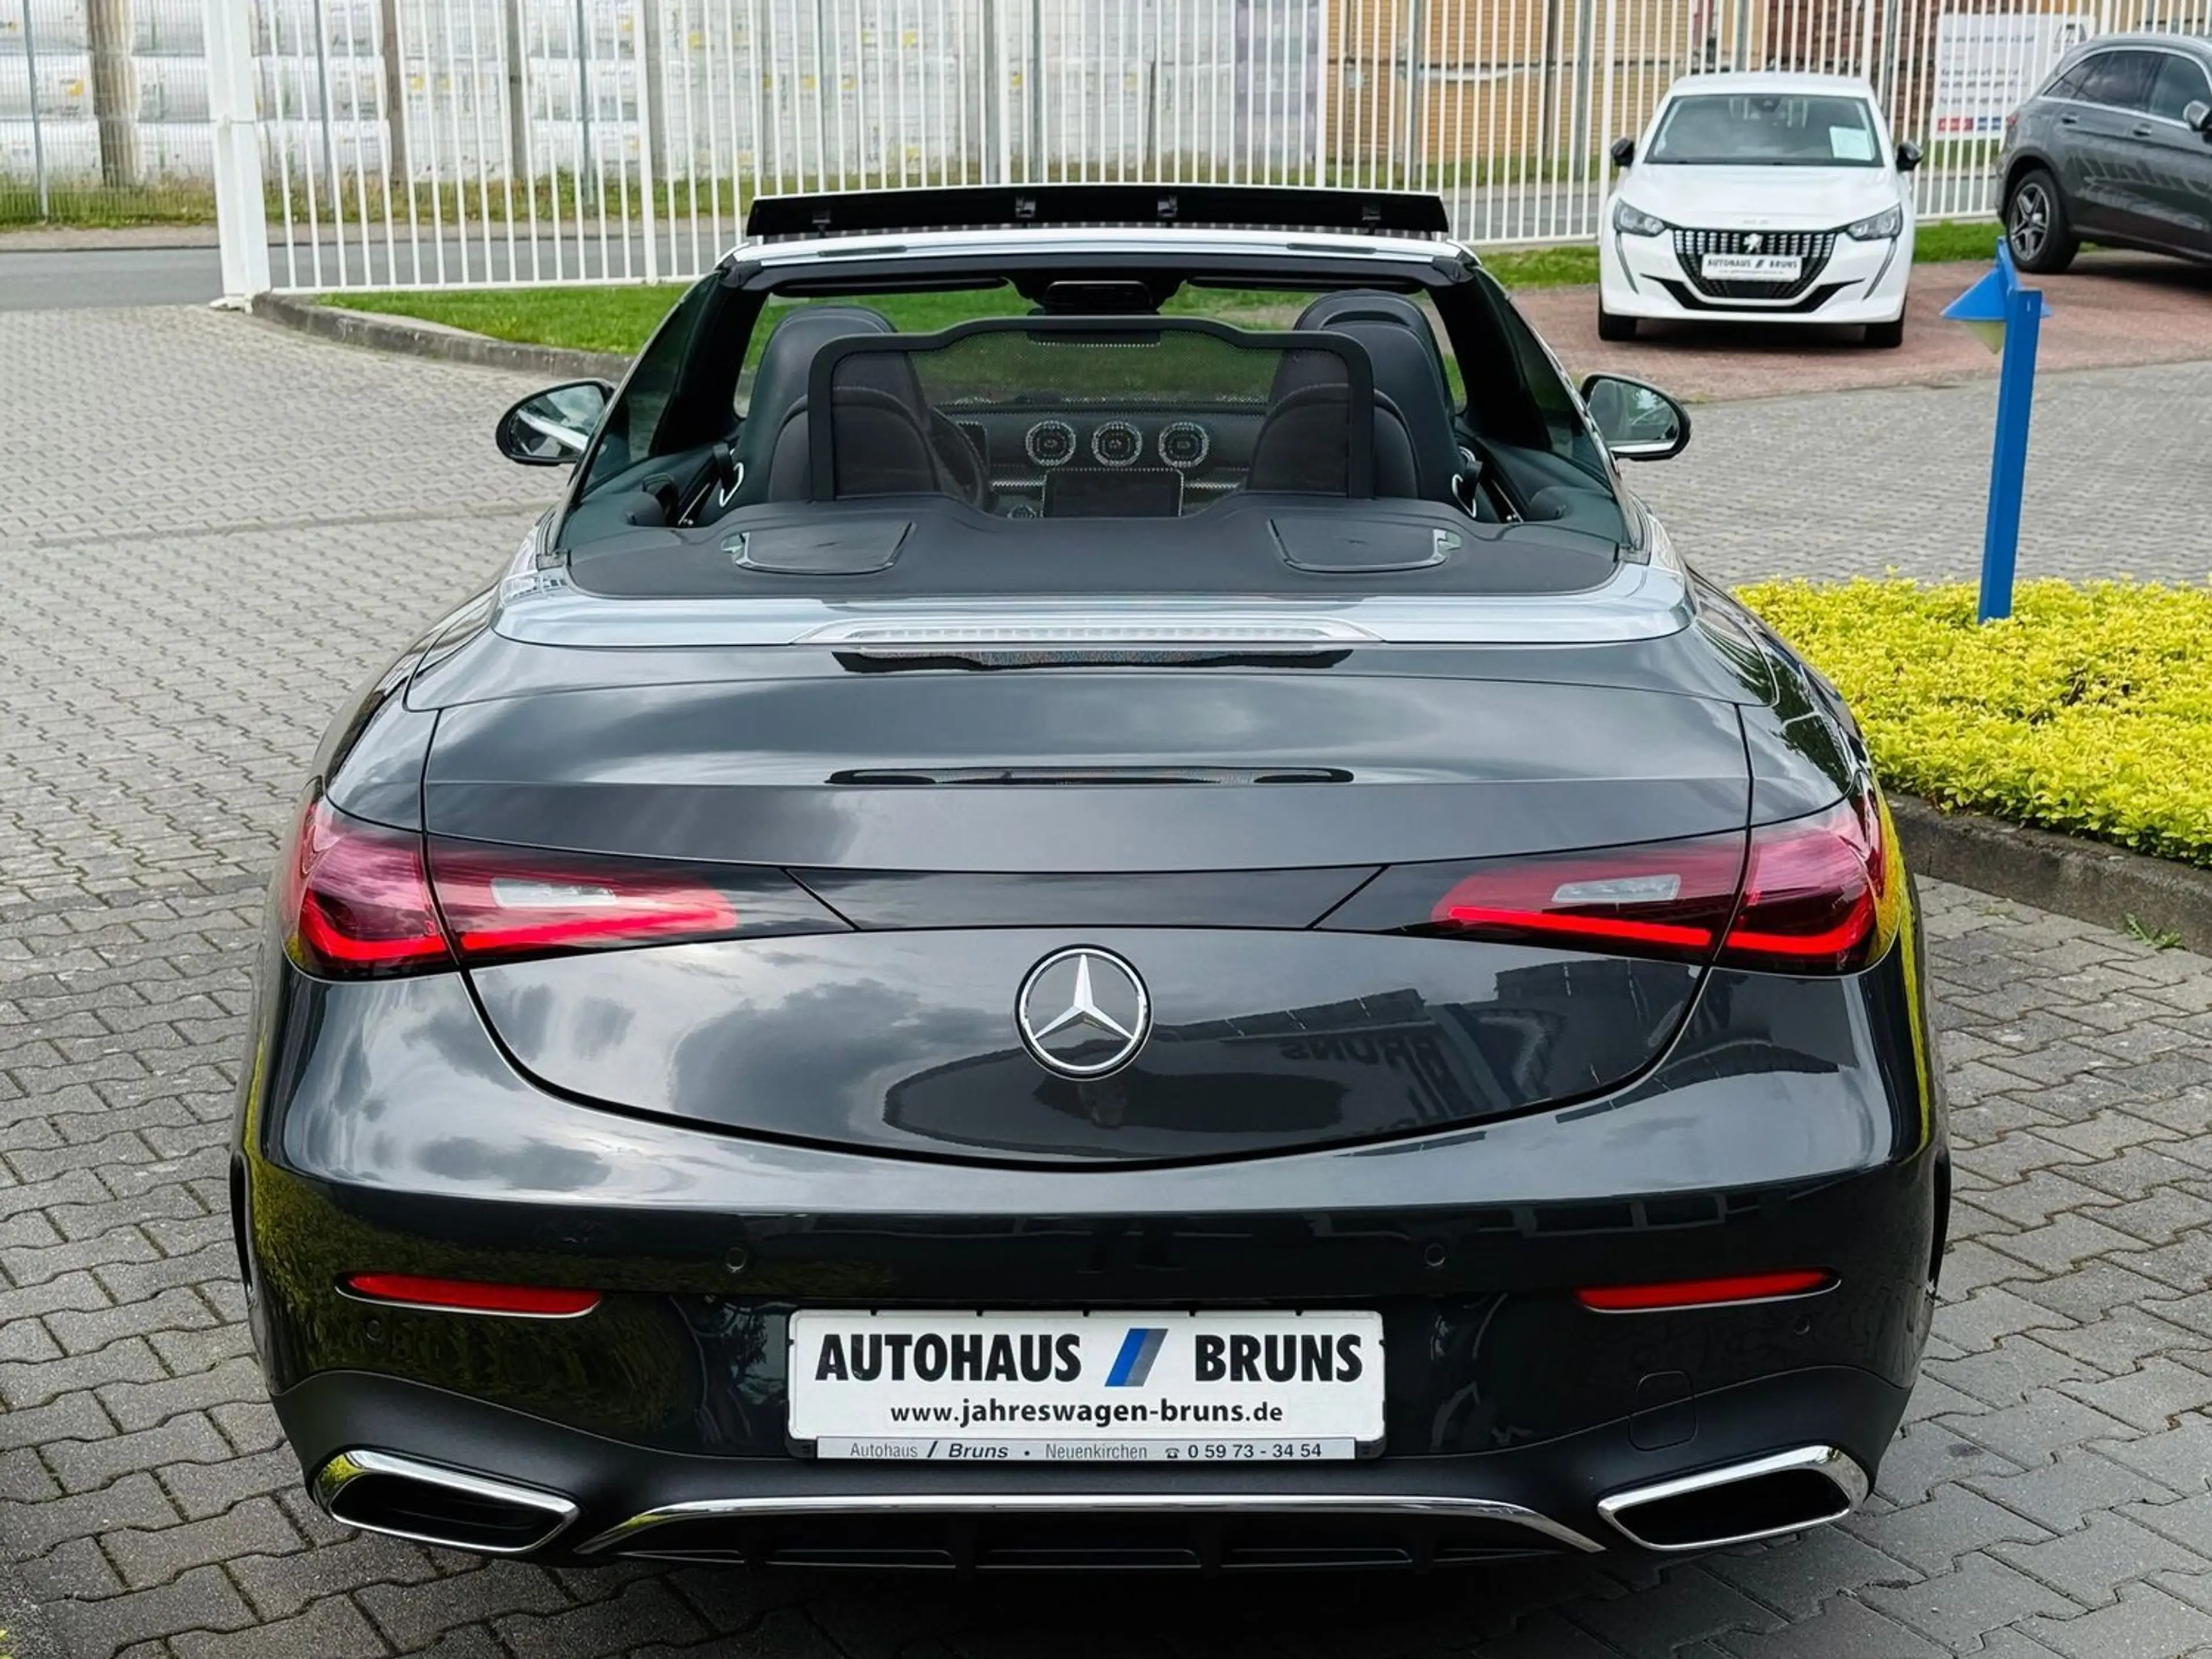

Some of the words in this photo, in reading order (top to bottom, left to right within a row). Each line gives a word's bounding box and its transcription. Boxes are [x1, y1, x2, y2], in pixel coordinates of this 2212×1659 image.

[1707, 258, 1751, 267] AUTOHAUS
[1769, 260, 1797, 269] BRUNS
[815, 1332, 1082, 1382] AUTOHAUS
[1195, 1334, 1363, 1383] BRUNS
[891, 1397, 1283, 1427] www.jahreswagen-bruns.de
[850, 1442, 918, 1458] Autohaus
[948, 1442, 1009, 1458] Bruns
[1044, 1442, 1148, 1459] Neuenkirchen
